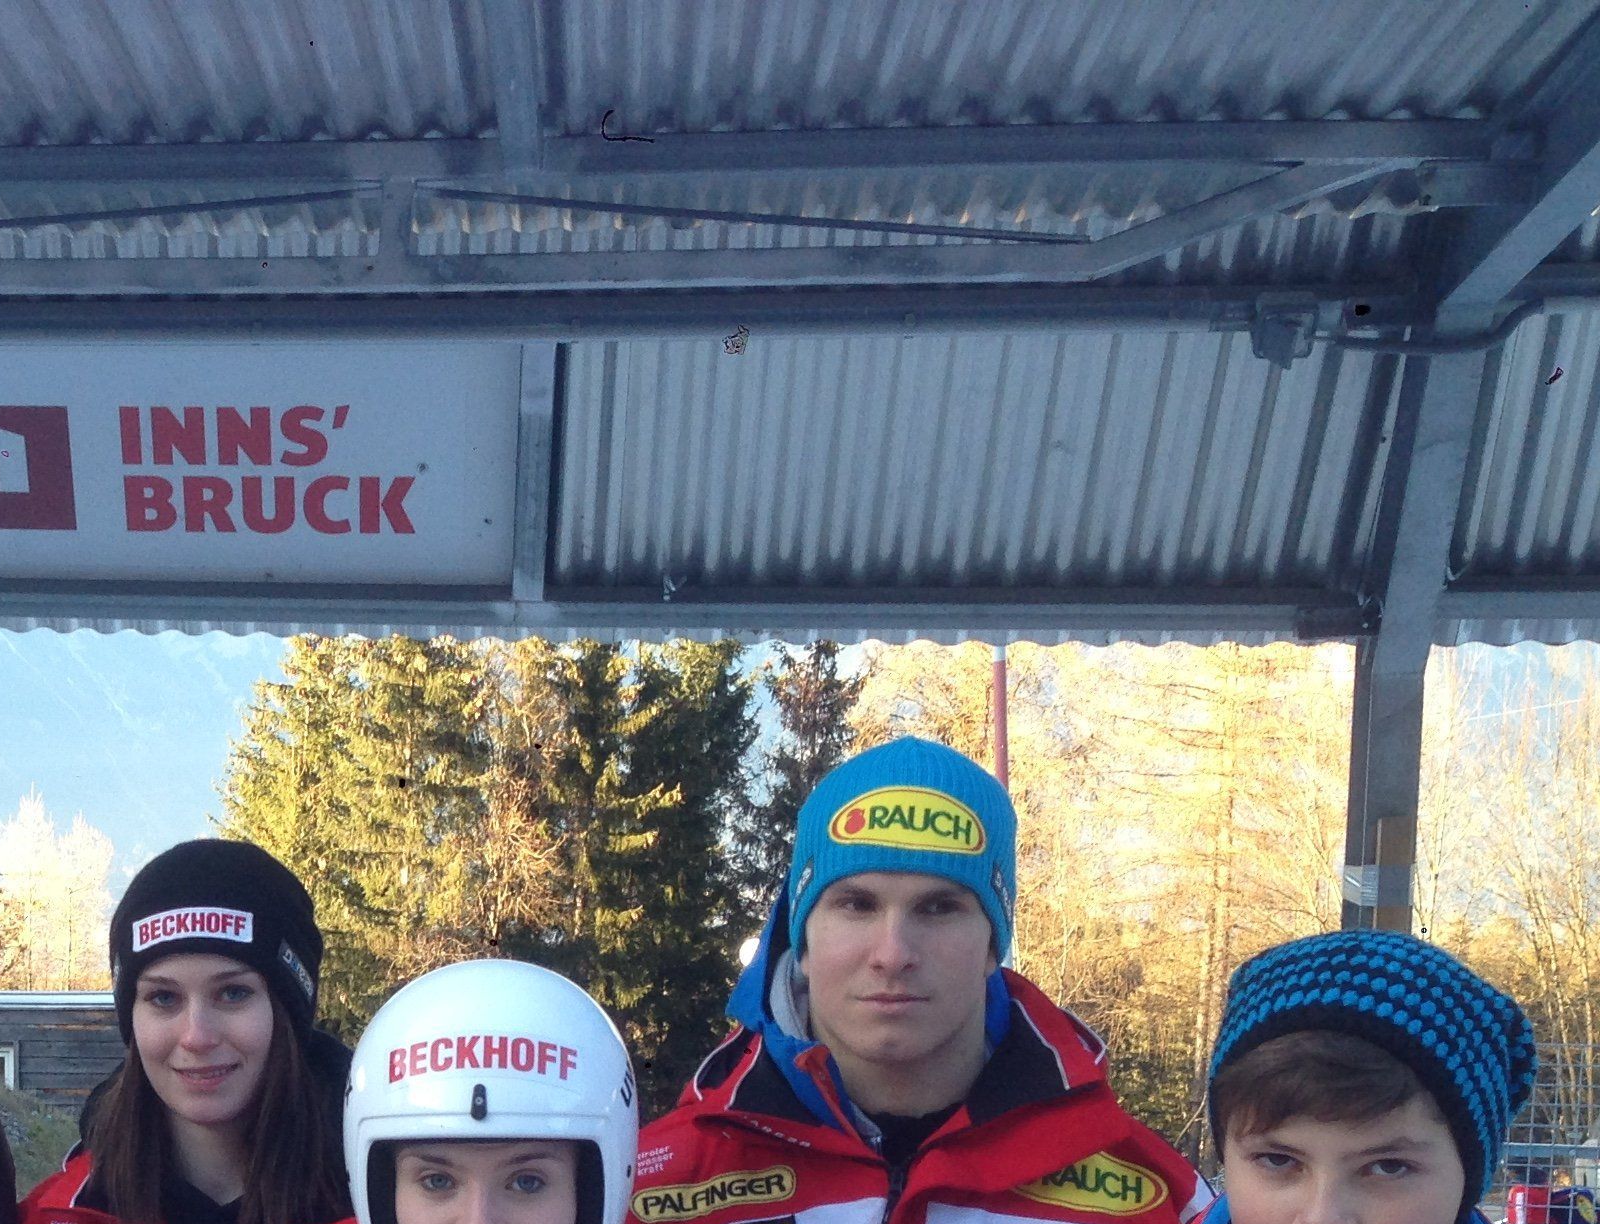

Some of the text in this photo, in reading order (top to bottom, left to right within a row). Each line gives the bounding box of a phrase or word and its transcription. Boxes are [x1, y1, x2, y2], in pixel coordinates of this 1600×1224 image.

[123, 475, 417, 535] BRUCK
[868, 804, 973, 845] RAUCH
[139, 912, 247, 946] BECKHOFF
[388, 1035, 578, 1084] BECKHOFF
[642, 1174, 787, 1216] PALFINGER
